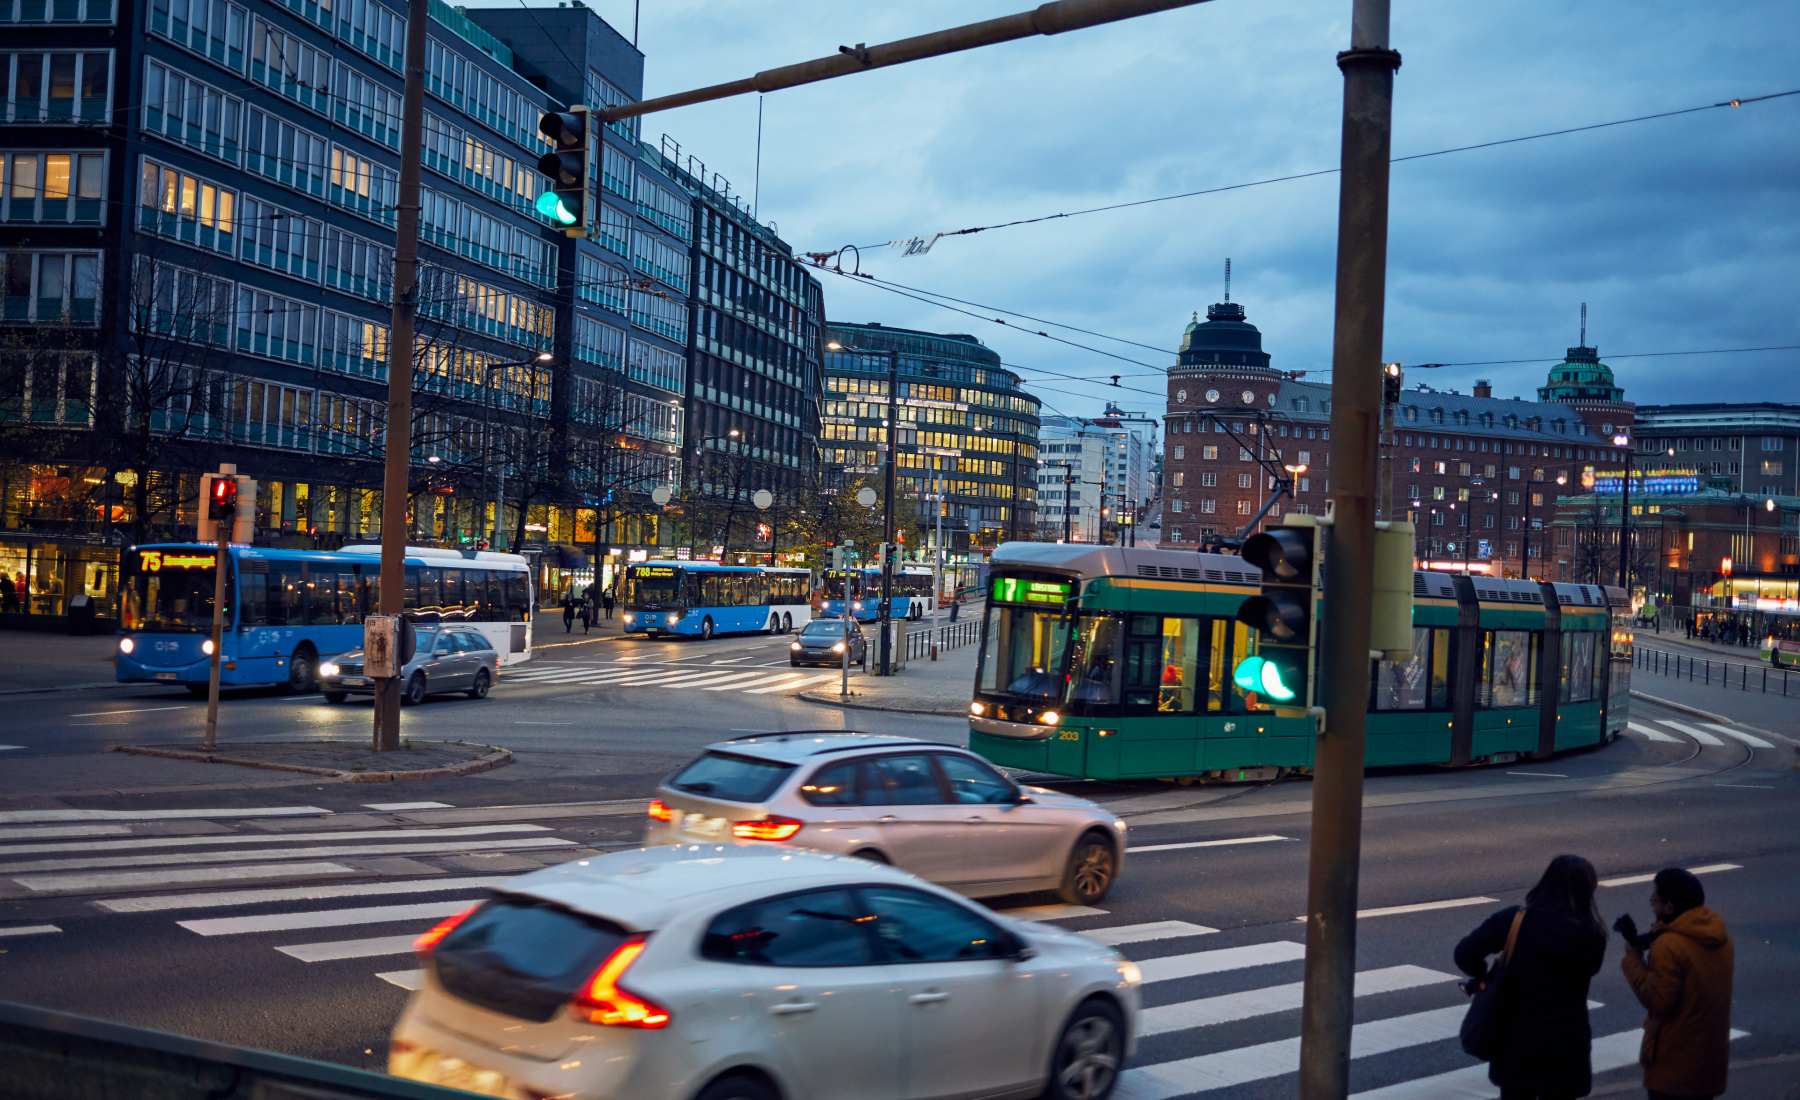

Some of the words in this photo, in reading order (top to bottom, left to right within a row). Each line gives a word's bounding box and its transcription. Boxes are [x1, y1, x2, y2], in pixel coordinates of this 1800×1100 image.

[140, 551, 161, 571] 75
[828, 570, 836, 578] 77
[1004, 578, 1016, 602] 7
[1059, 730, 1080, 741] 203
